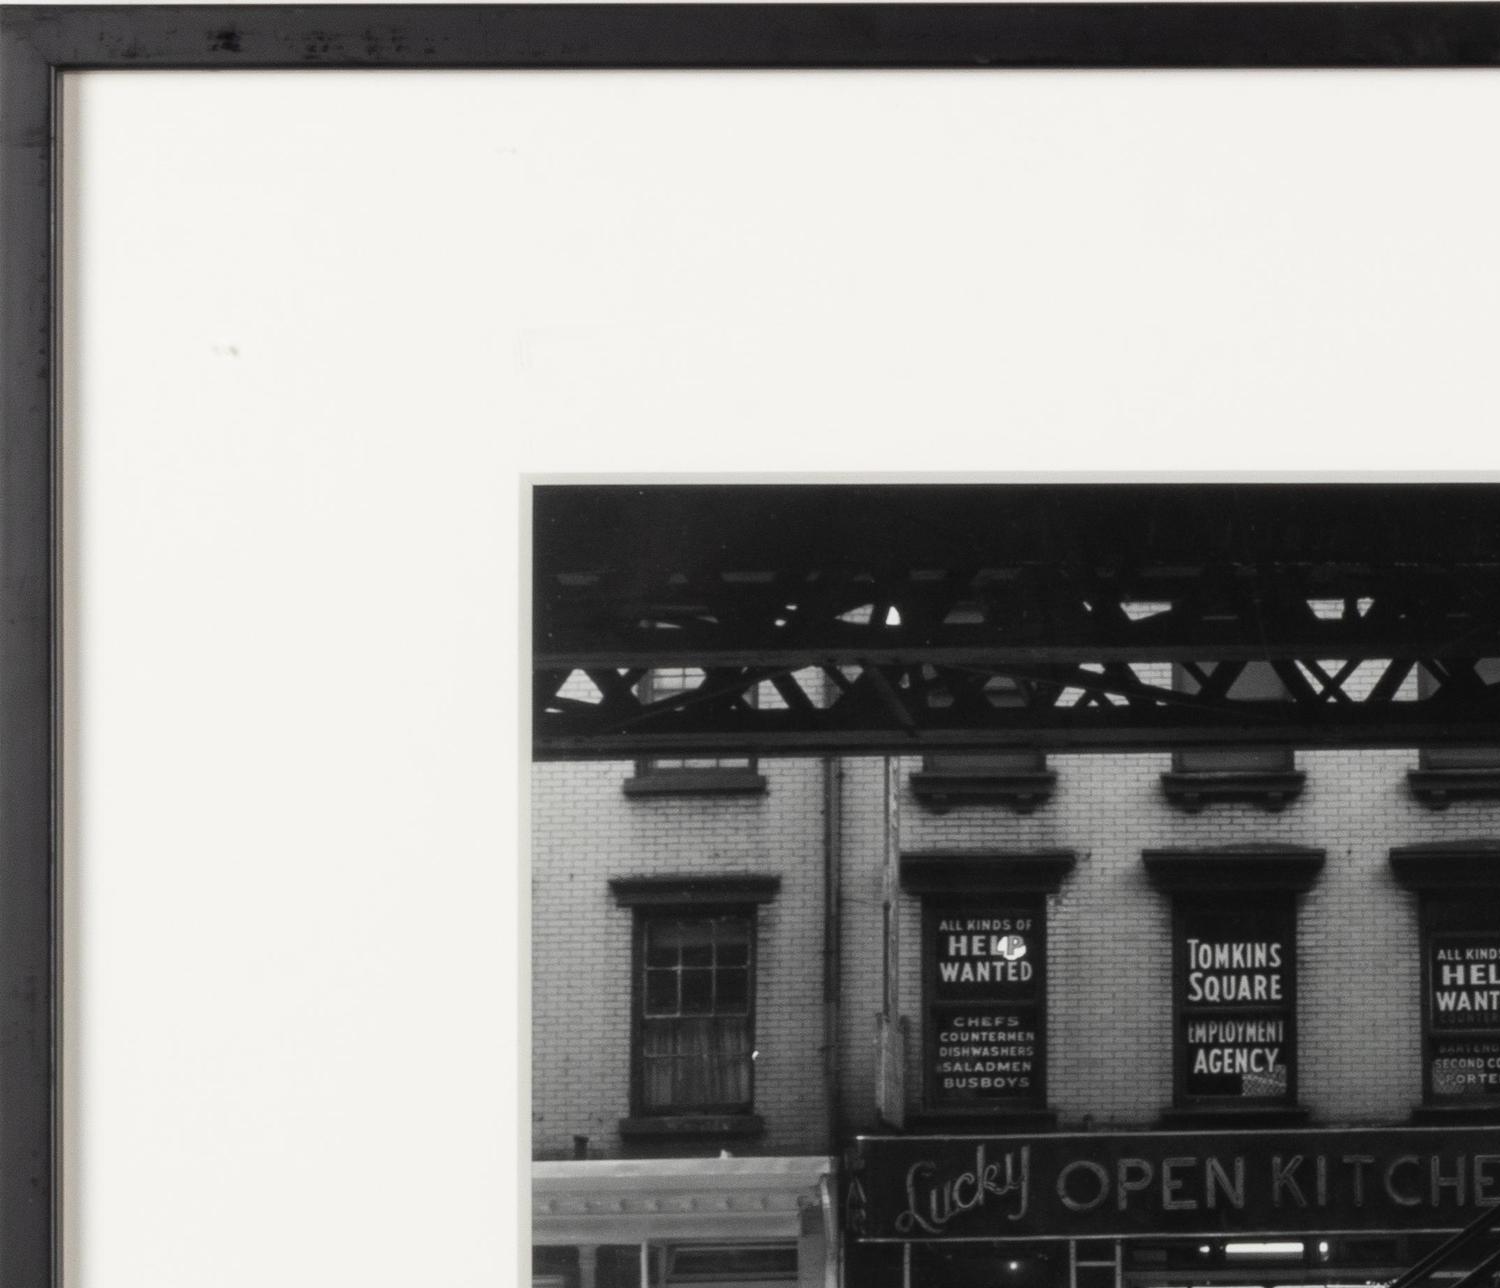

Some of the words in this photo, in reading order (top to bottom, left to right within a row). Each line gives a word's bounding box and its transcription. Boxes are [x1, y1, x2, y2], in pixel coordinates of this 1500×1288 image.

[939, 920, 963, 932] ALL
[966, 919, 1012, 931] KINDS
[1015, 919, 1033, 931] OF
[948, 934, 1027, 961] HELP
[1186, 938, 1283, 970] TOMKINS
[1437, 948, 1463, 961] ALL
[939, 961, 1034, 982] WANTED
[1187, 971, 1283, 1003] SQUARE
[953, 1016, 1020, 1028] CHEFS
[940, 1031, 1035, 1042] COUNTERMEN
[1187, 1020, 1284, 1044] EMPLOYMENT
[939, 1046, 1034, 1057] DISHWASHERS
[942, 1060, 1032, 1072] SALADMEN
[1193, 1048, 1280, 1075] AGENCY
[1434, 1057, 1484, 1069] SECOND
[943, 1076, 1030, 1089] BUSBOYS
[895, 1144, 1030, 1233] Lucky
[1056, 1156, 1245, 1211] OPEN
